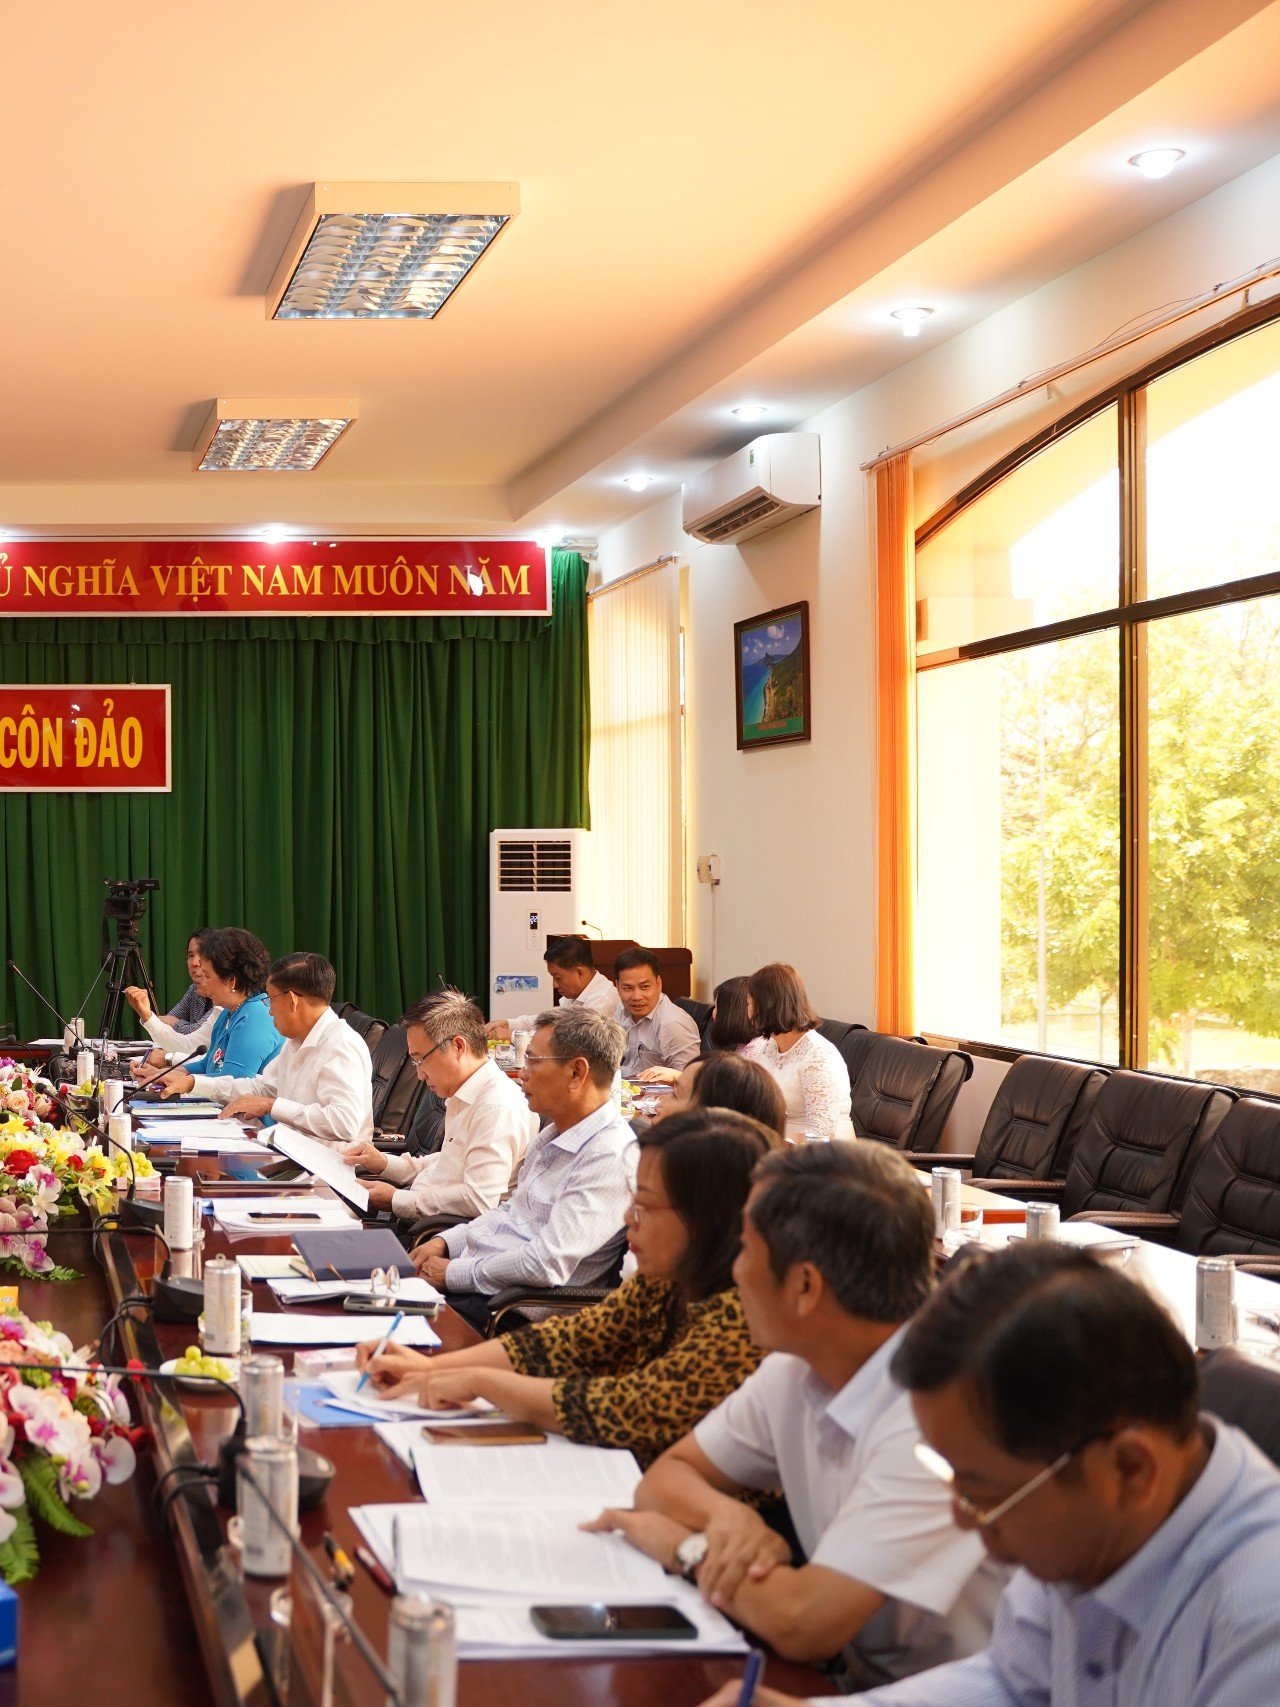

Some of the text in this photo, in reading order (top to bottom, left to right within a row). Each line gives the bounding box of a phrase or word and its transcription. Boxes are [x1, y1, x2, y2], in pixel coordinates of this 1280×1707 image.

[23, 558, 140, 597] NGHĨA
[150, 557, 233, 602] VIỆT
[241, 564, 323, 596] NAM
[332, 556, 440, 596] MUÔN
[448, 556, 532, 596] NĂM
[74, 698, 143, 769] ĐẢO
